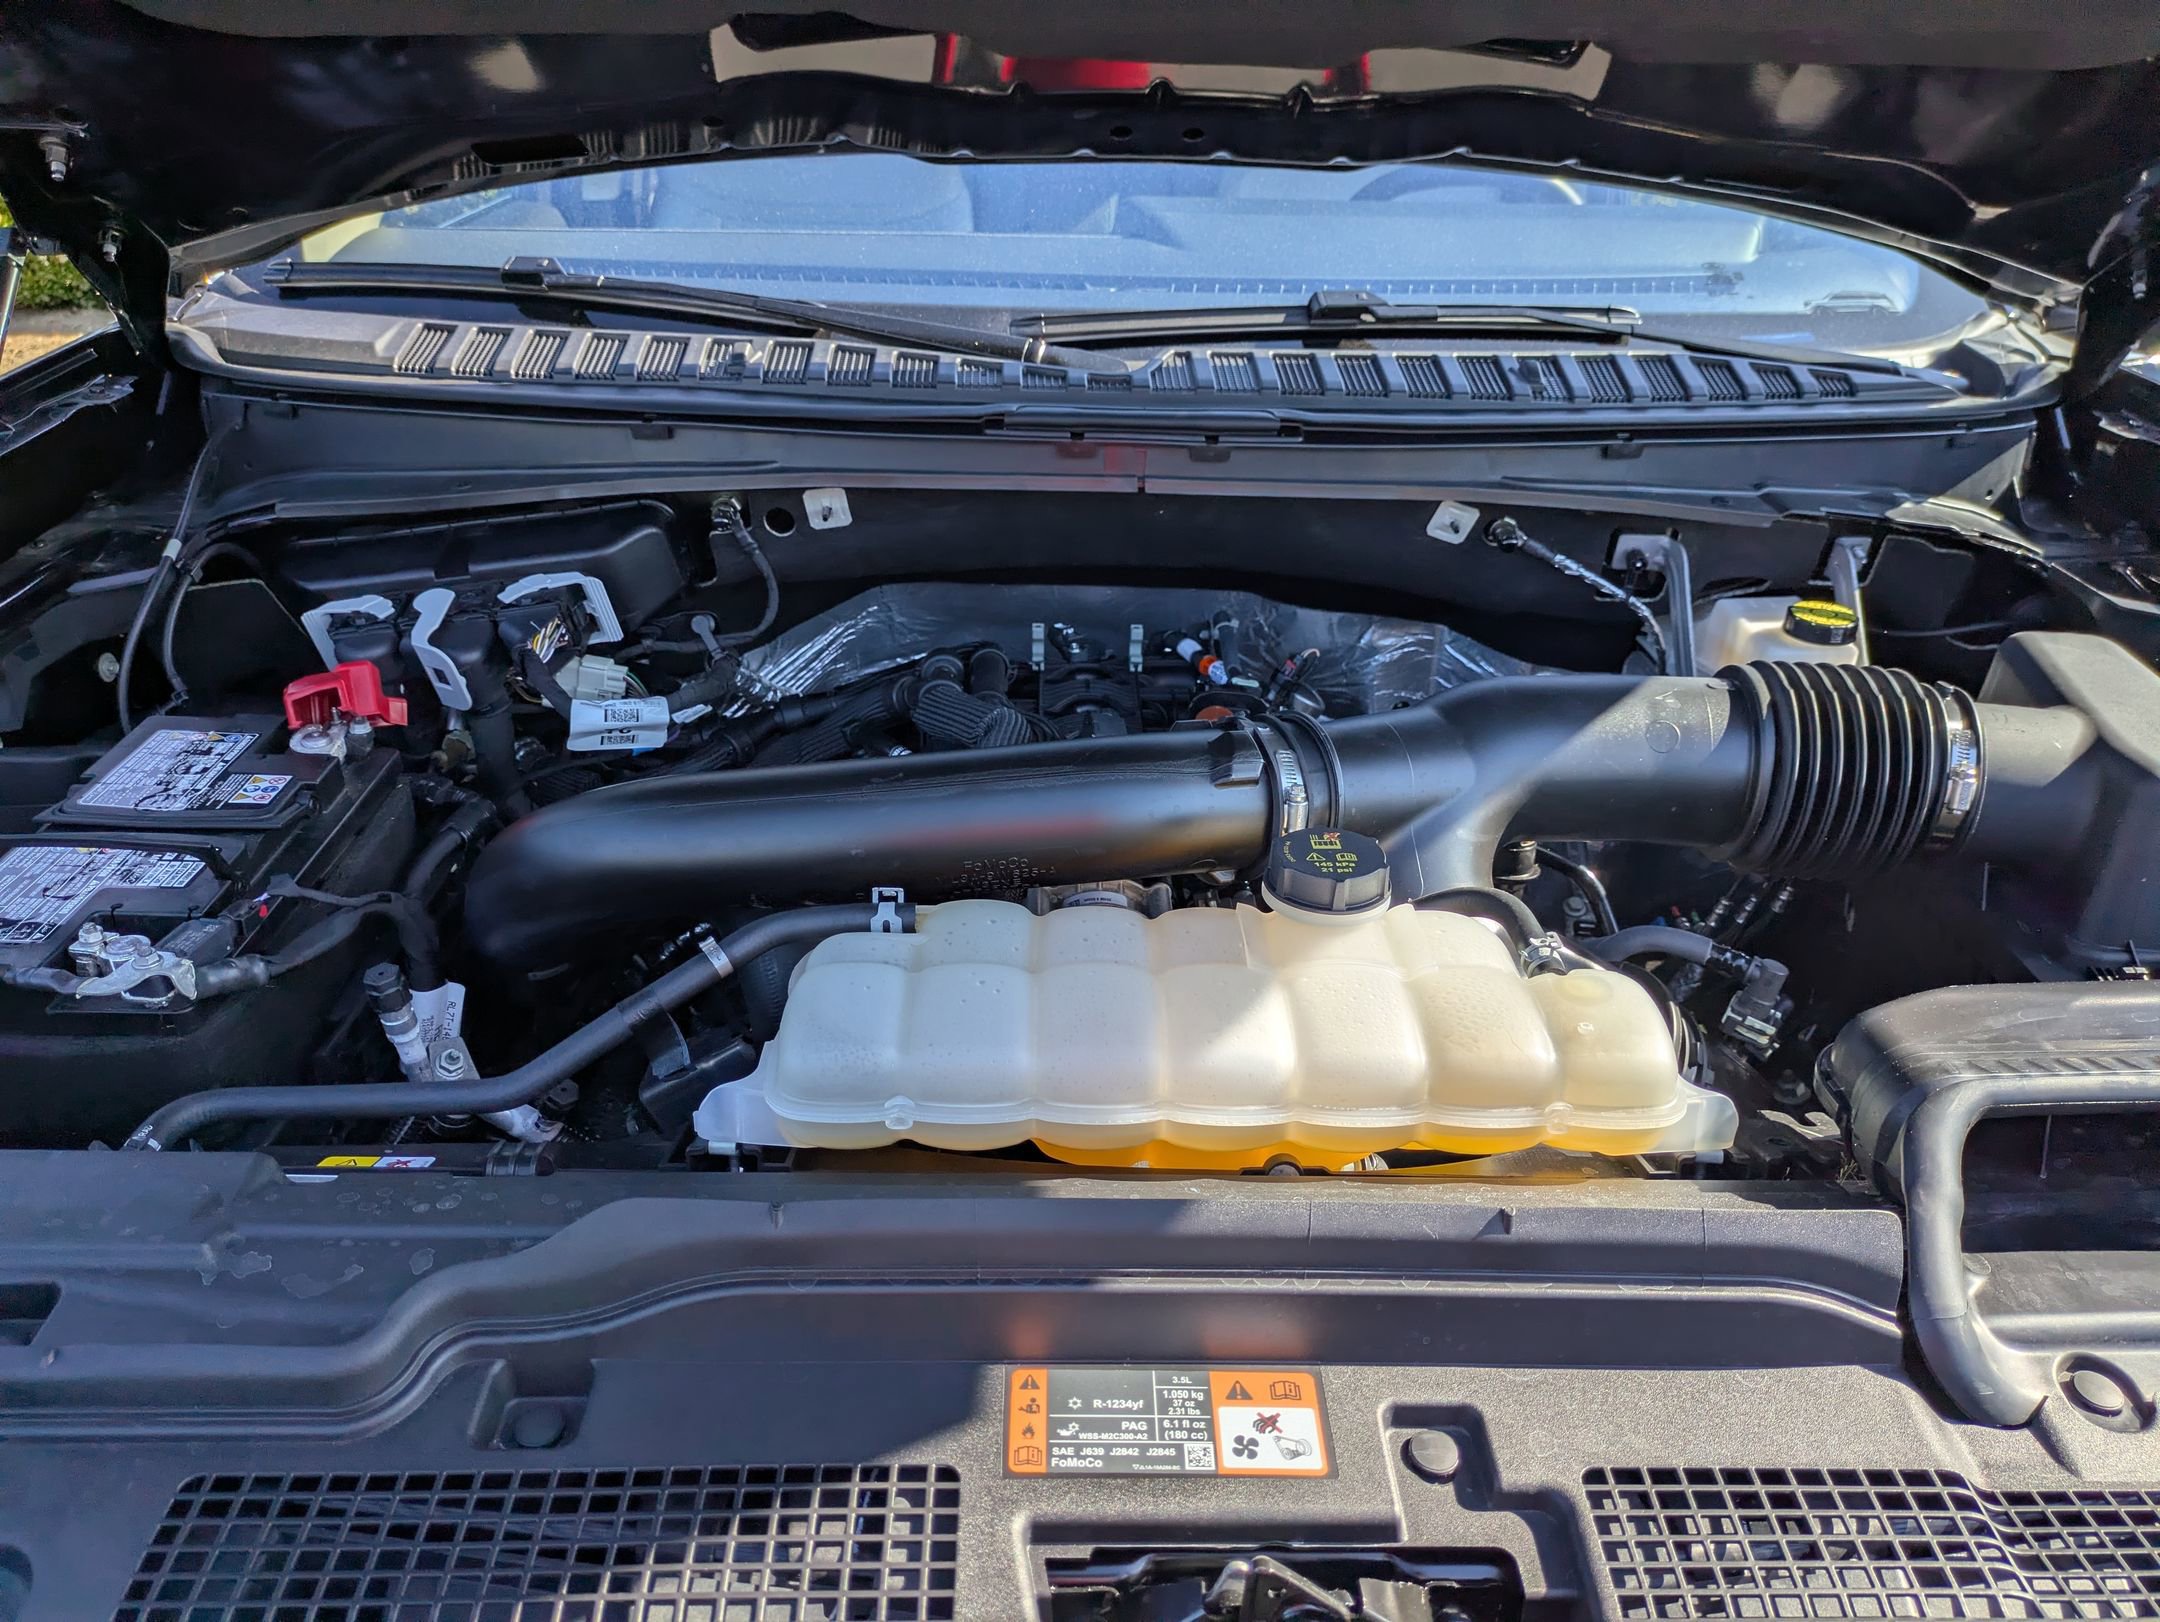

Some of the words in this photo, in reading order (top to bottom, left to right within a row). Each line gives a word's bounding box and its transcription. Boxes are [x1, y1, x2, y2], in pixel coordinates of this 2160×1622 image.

[1172, 1376, 1193, 1384] 3.5L
[1162, 1389, 1189, 1399] 1.050
[1191, 1389, 1204, 1401] kg
[1093, 1399, 1144, 1411] R-1234yf
[1172, 1399, 1183, 1407] 37
[1168, 1407, 1186, 1415] 2.31
[1187, 1407, 1201, 1415] lbs
[1121, 1421, 1148, 1431] PAG
[1162, 1419, 1179, 1428] 6.1
[1182, 1419, 1190, 1428] fl
[1192, 1421, 1207, 1429] oz
[1078, 1432, 1148, 1440] WSS-M2C300-A2
[1164, 1430, 1188, 1441] (180
[1190, 1430, 1208, 1441] cc)
[1052, 1447, 1075, 1456] SAE
[1080, 1447, 1105, 1456] J639
[1109, 1447, 1140, 1456] J2842
[1146, 1447, 1177, 1456] J2845
[1051, 1457, 1103, 1468] FoMoCo
